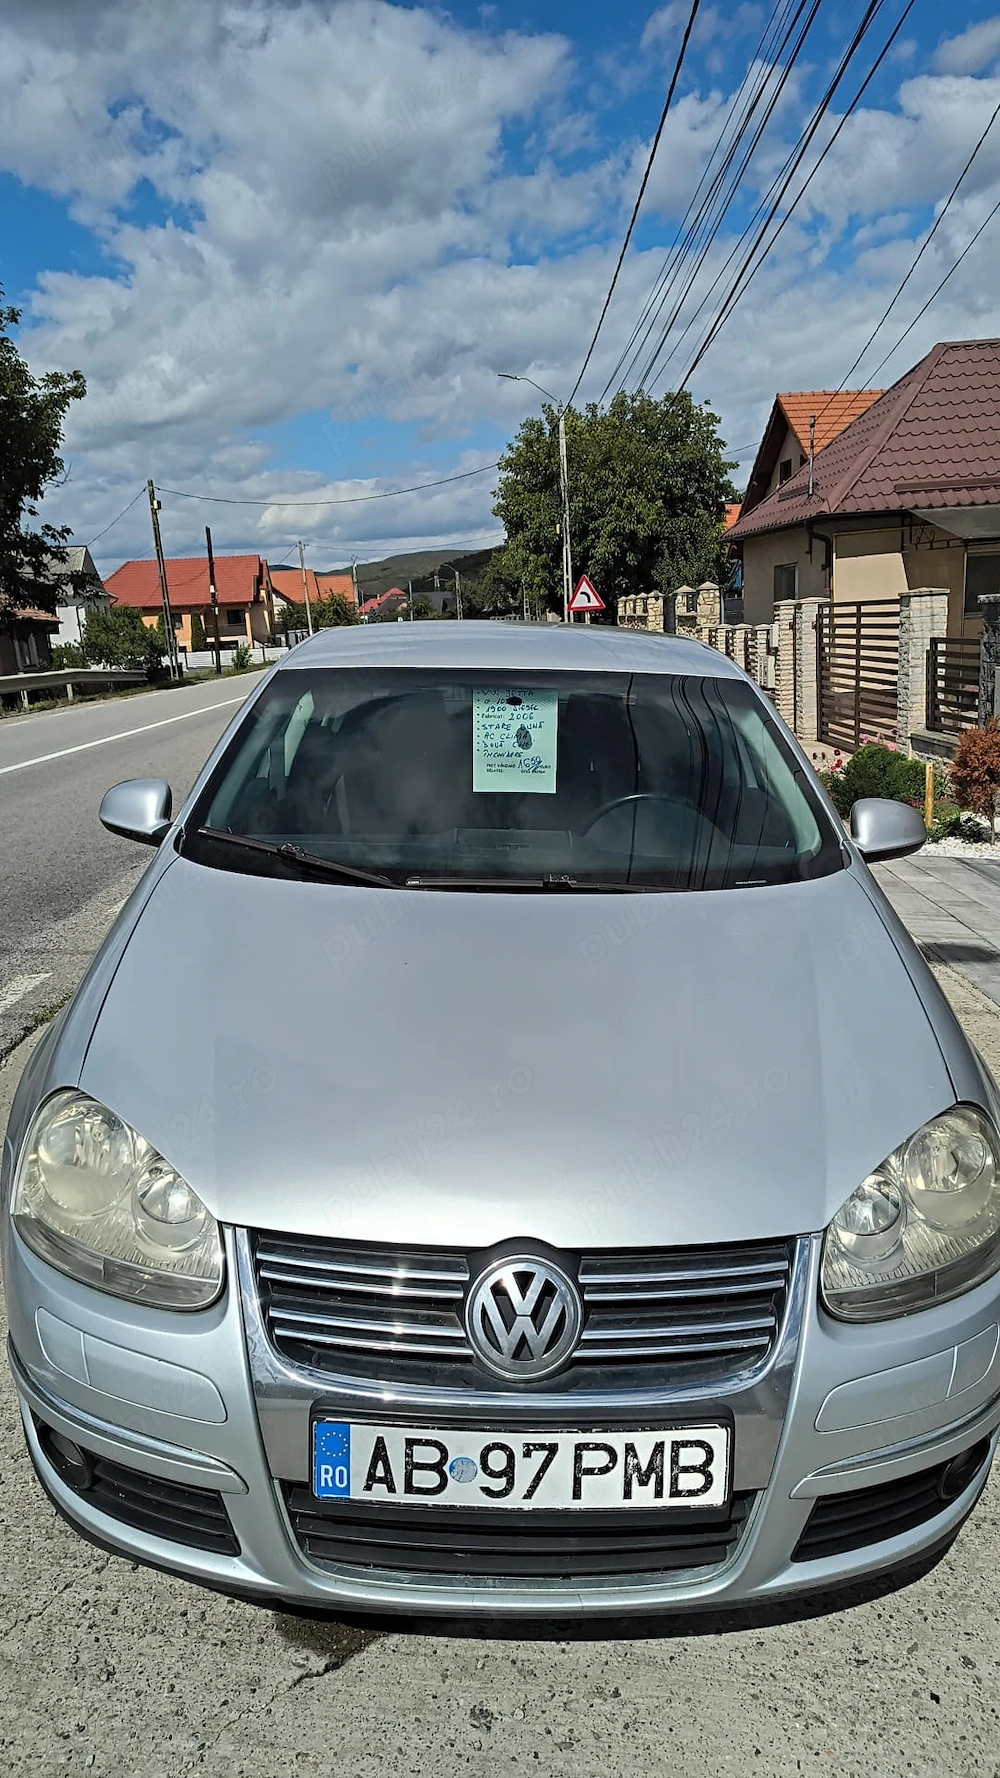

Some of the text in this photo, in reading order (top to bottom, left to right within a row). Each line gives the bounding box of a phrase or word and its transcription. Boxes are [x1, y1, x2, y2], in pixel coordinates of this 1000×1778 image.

[508, 712, 535, 721] 2006
[484, 732, 495, 740] AC
[471, 1260, 576, 1373] VW
[321, 1464, 348, 1489] RO
[363, 1436, 714, 1500] AB 97 PMB
